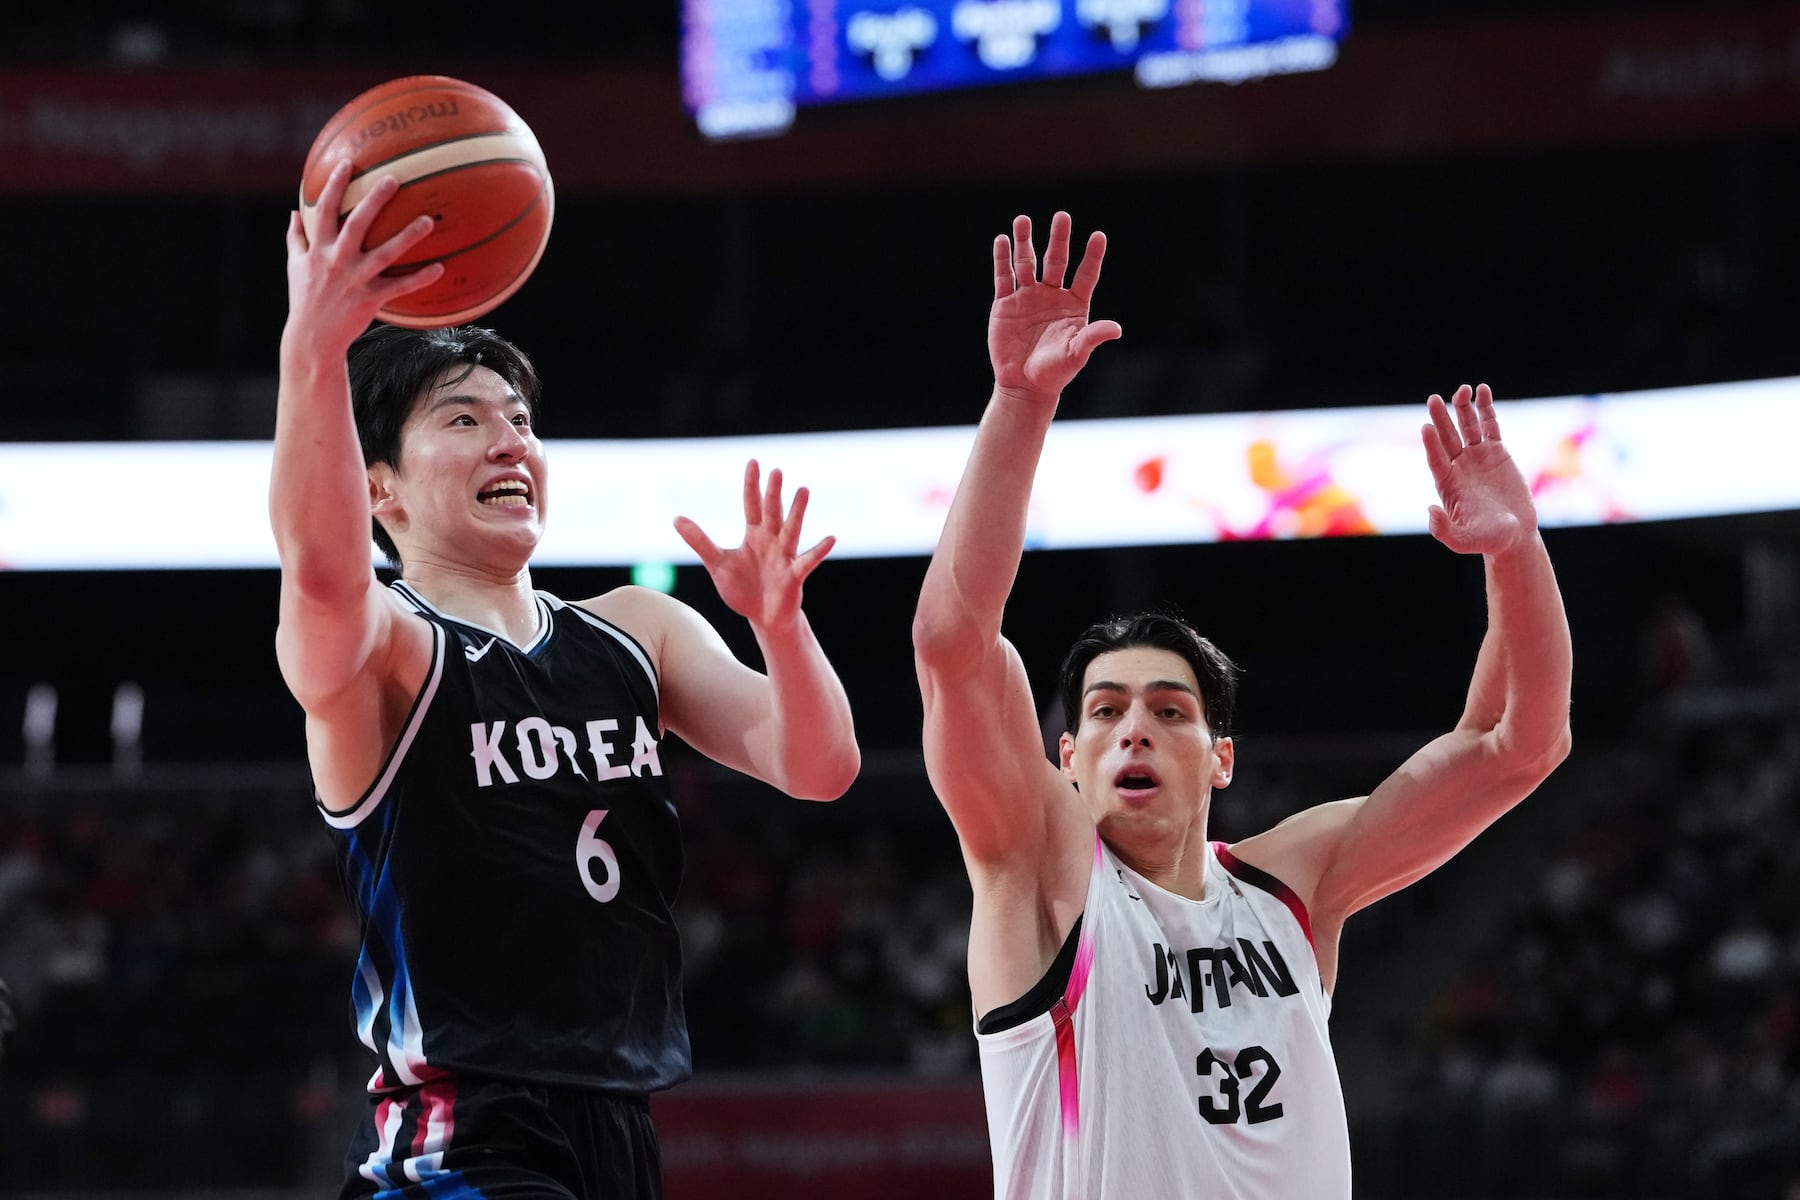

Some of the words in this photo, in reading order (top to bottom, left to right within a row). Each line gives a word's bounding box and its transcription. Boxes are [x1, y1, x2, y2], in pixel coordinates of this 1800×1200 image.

[350, 101, 460, 149] molten
[576, 809, 621, 903] 6
[1196, 1045, 1283, 1124] 32
